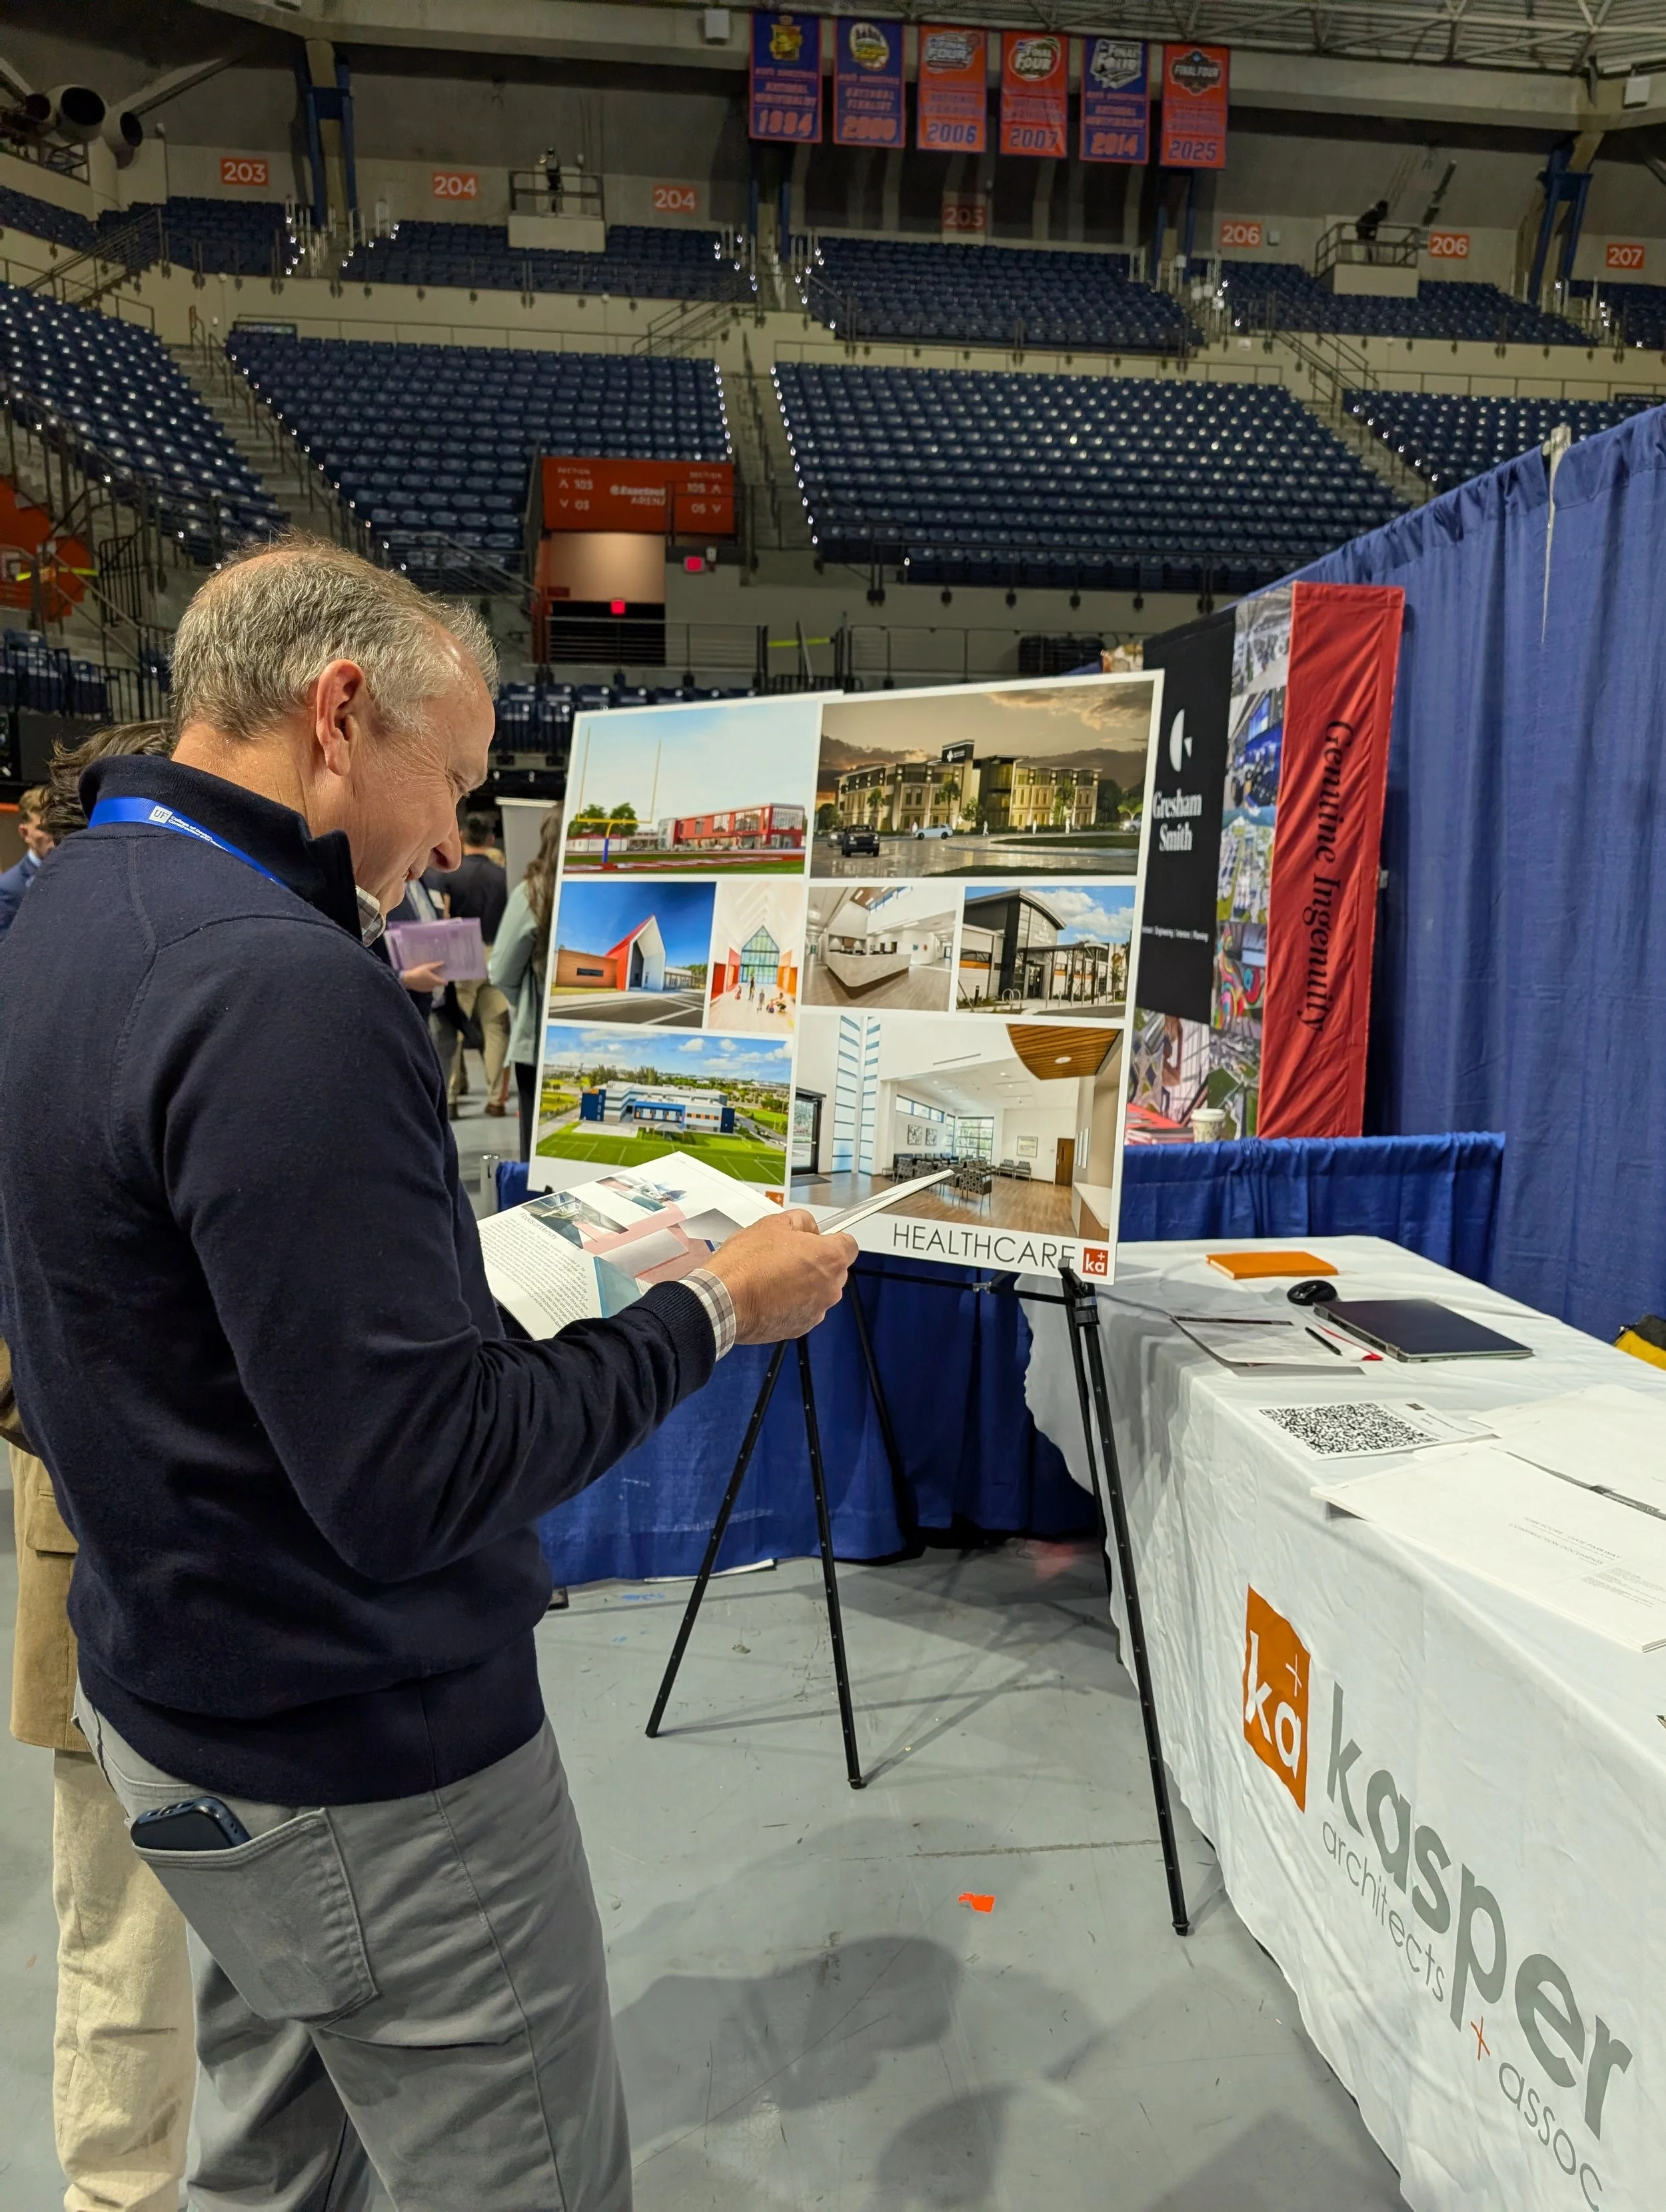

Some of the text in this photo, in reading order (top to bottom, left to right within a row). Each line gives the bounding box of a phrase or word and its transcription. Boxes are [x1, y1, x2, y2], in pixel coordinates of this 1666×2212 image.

[926, 122, 978, 145] 2006
[1009, 127, 1059, 149] 2007
[1091, 132, 1139, 157] 2014
[1169, 140, 1218, 161] 2025
[224, 161, 267, 183] 203
[434, 175, 477, 197] 204
[654, 189, 695, 210] 204
[1222, 225, 1260, 245] 206
[1431, 237, 1468, 256] 206
[1609, 247, 1643, 266] 207
[154, 810, 169, 819] UF
[1152, 788, 1202, 819] Gresham
[168, 819, 201, 836] Construction
[171, 816, 190, 828] College
[1159, 821, 1193, 851] Smith
[1297, 721, 1353, 1031] Genuine Ingenuity
[893, 1223, 1076, 1270] HEALTHCARE
[1326, 1681, 1633, 2141] kasper
[1322, 1820, 1446, 2002] architects
[1499, 2062, 1603, 2211] assoc
